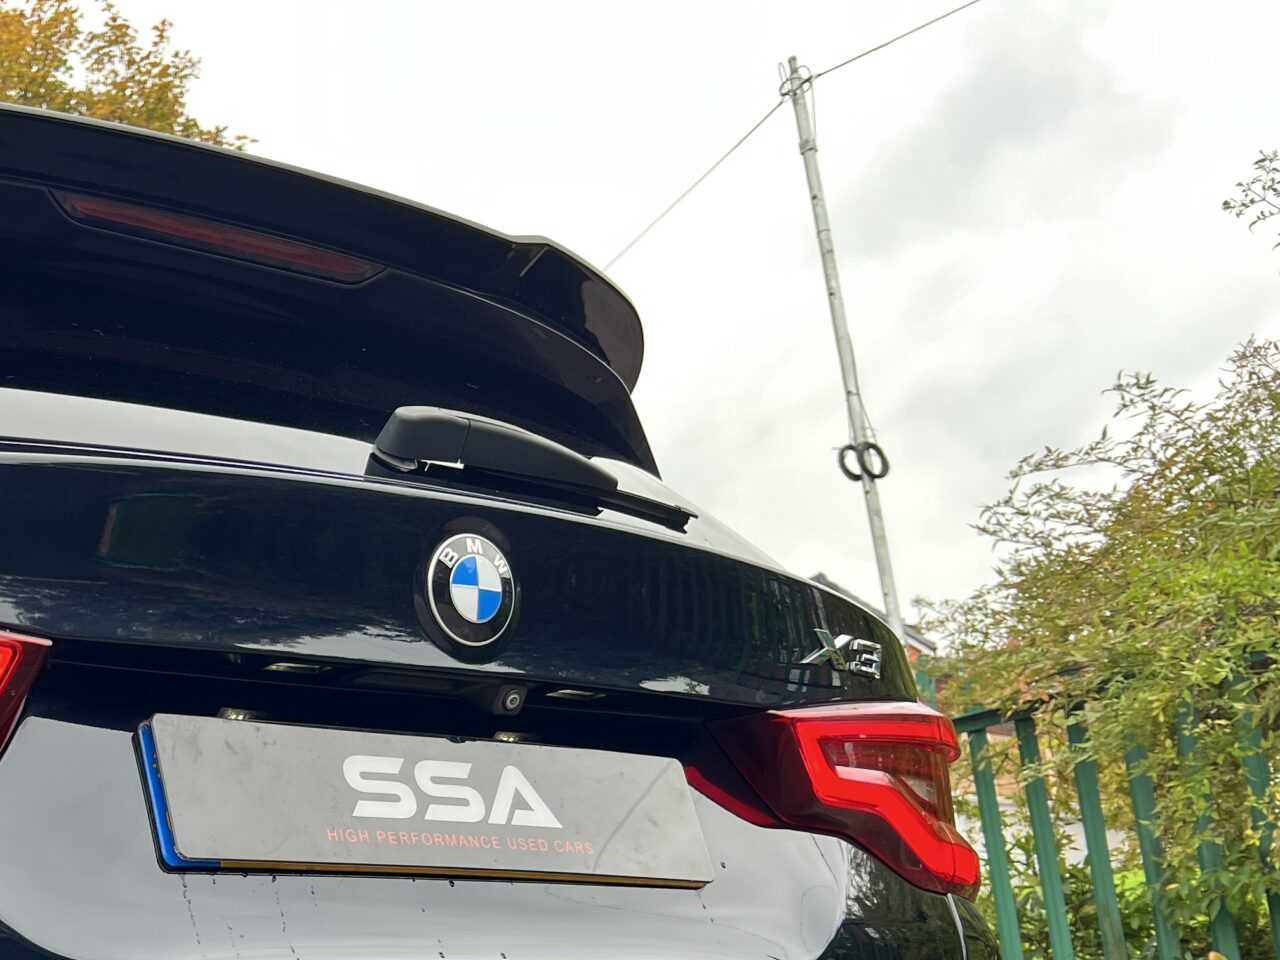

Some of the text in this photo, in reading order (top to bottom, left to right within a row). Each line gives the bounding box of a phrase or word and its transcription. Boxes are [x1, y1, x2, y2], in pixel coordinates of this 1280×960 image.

[439, 538, 508, 574] BMW
[799, 628, 882, 679] X3
[343, 755, 563, 828] SSA
[326, 828, 595, 855] HIGH PERFORMANCE USED CARS
